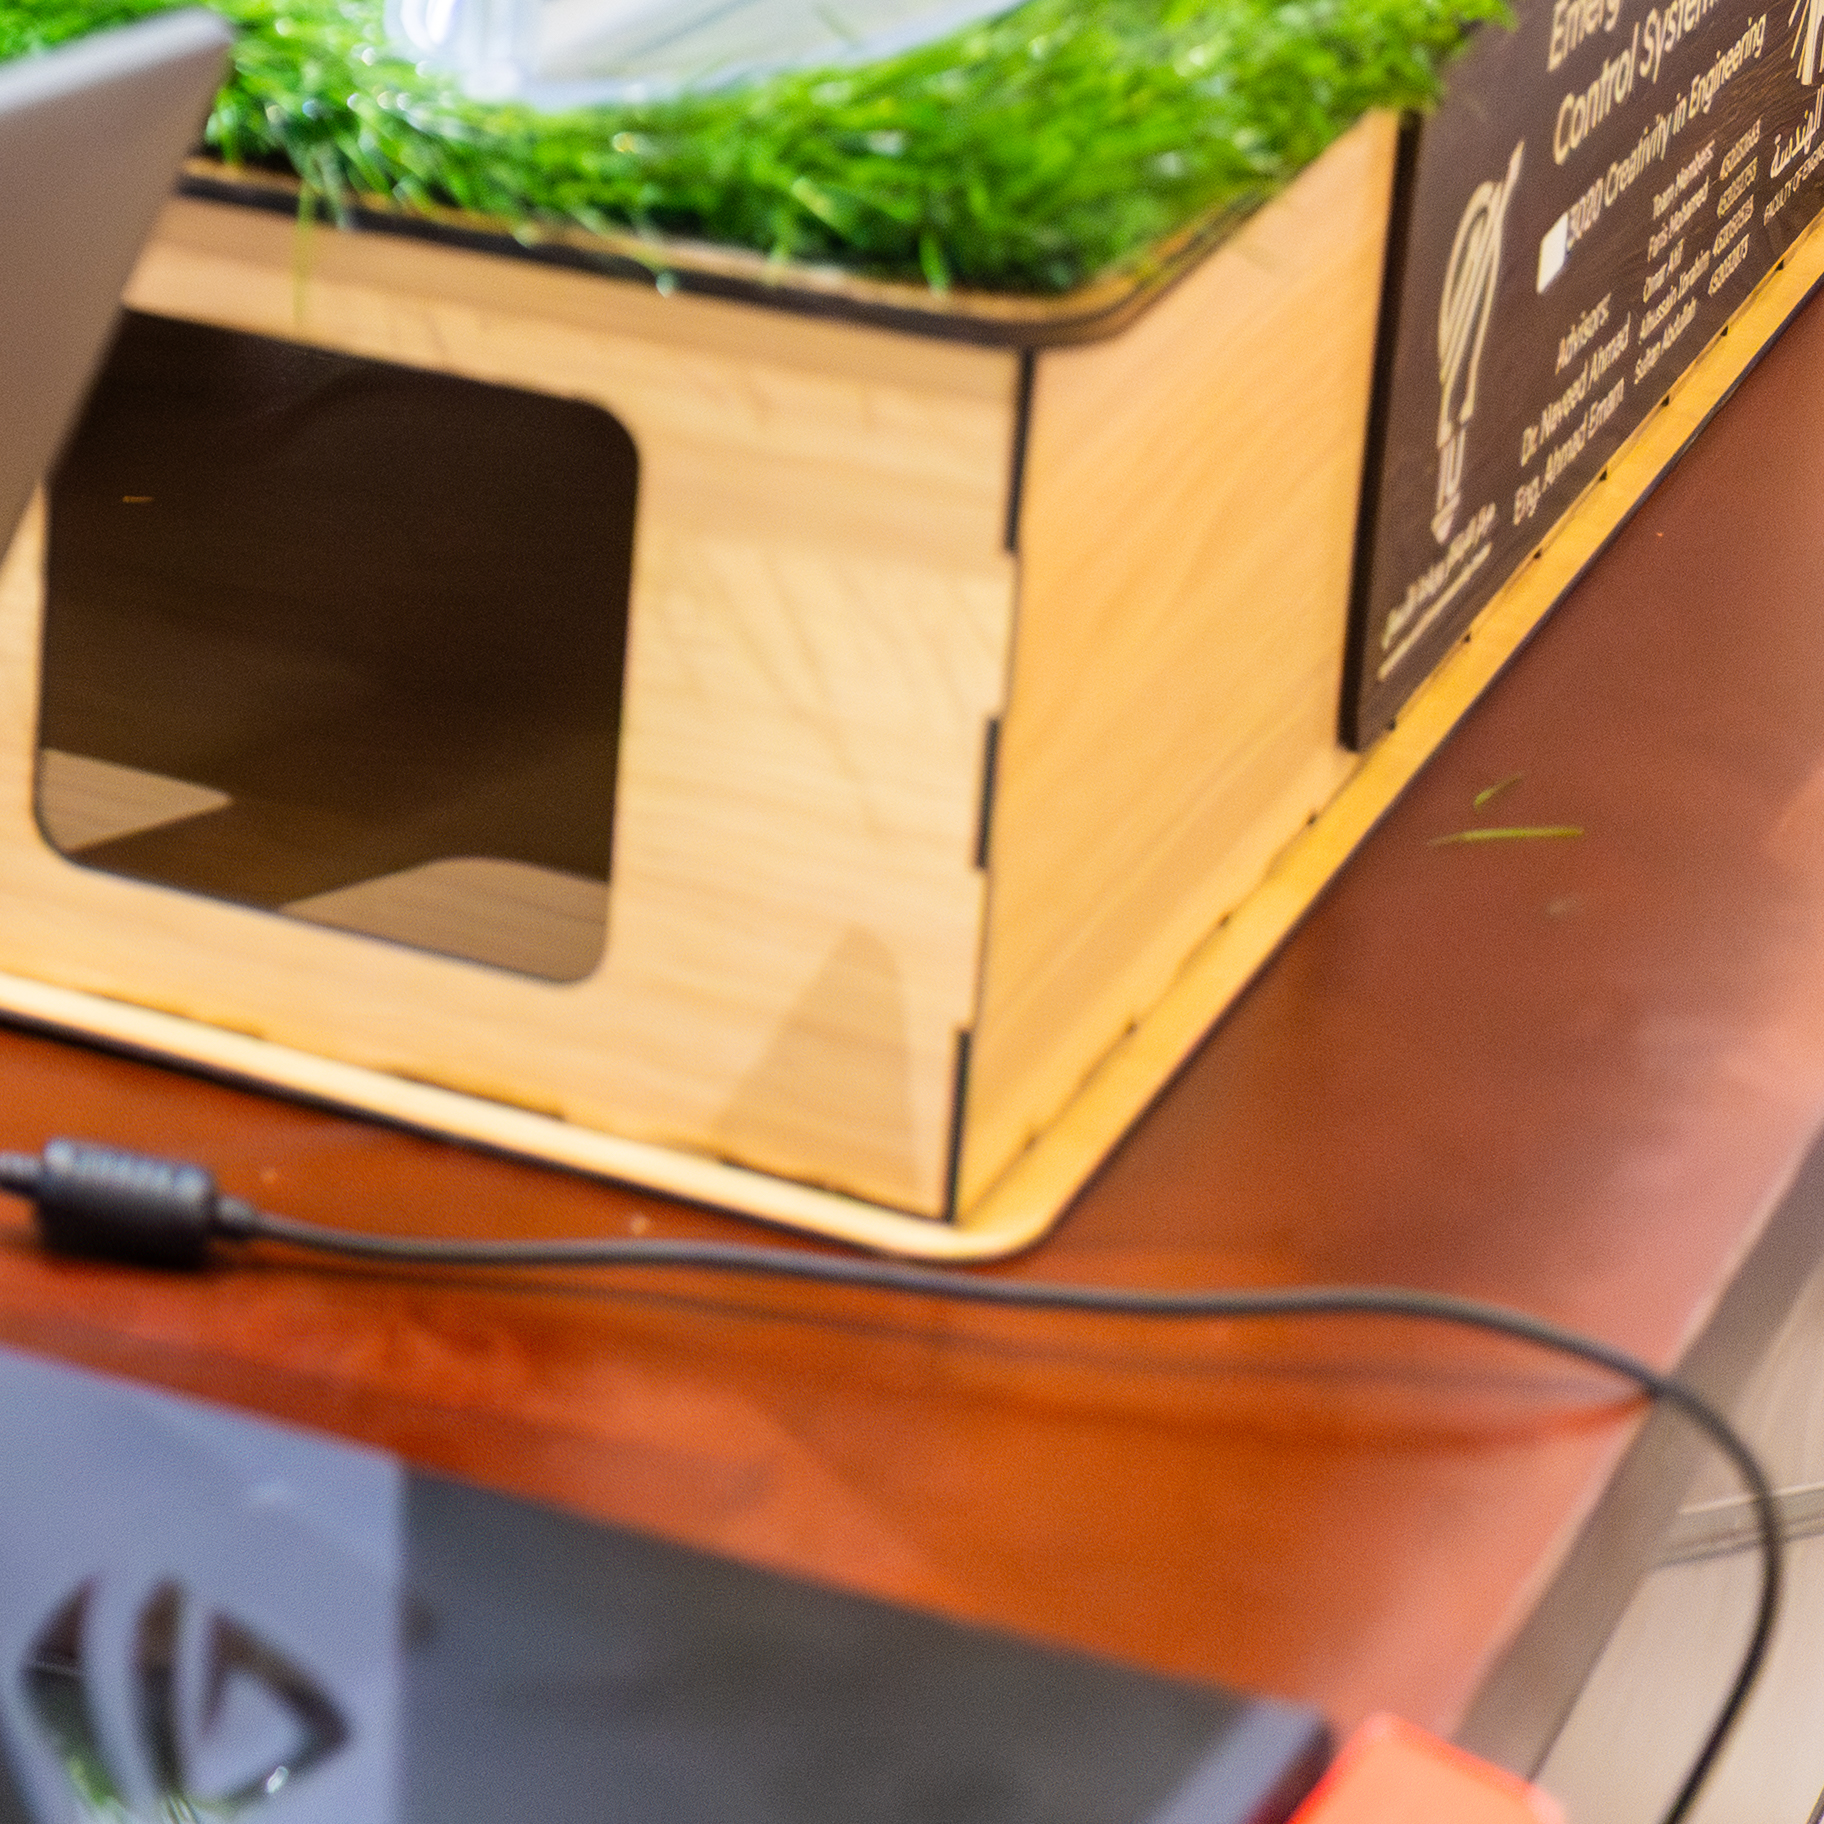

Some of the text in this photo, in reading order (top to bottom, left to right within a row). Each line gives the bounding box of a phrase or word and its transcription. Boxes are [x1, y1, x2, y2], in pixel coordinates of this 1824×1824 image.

[1554, 21, 1640, 166] Control
[1604, 113, 1673, 207] Creativity
[1673, 93, 1687, 136] in
[1688, 14, 1766, 120] Engineering
